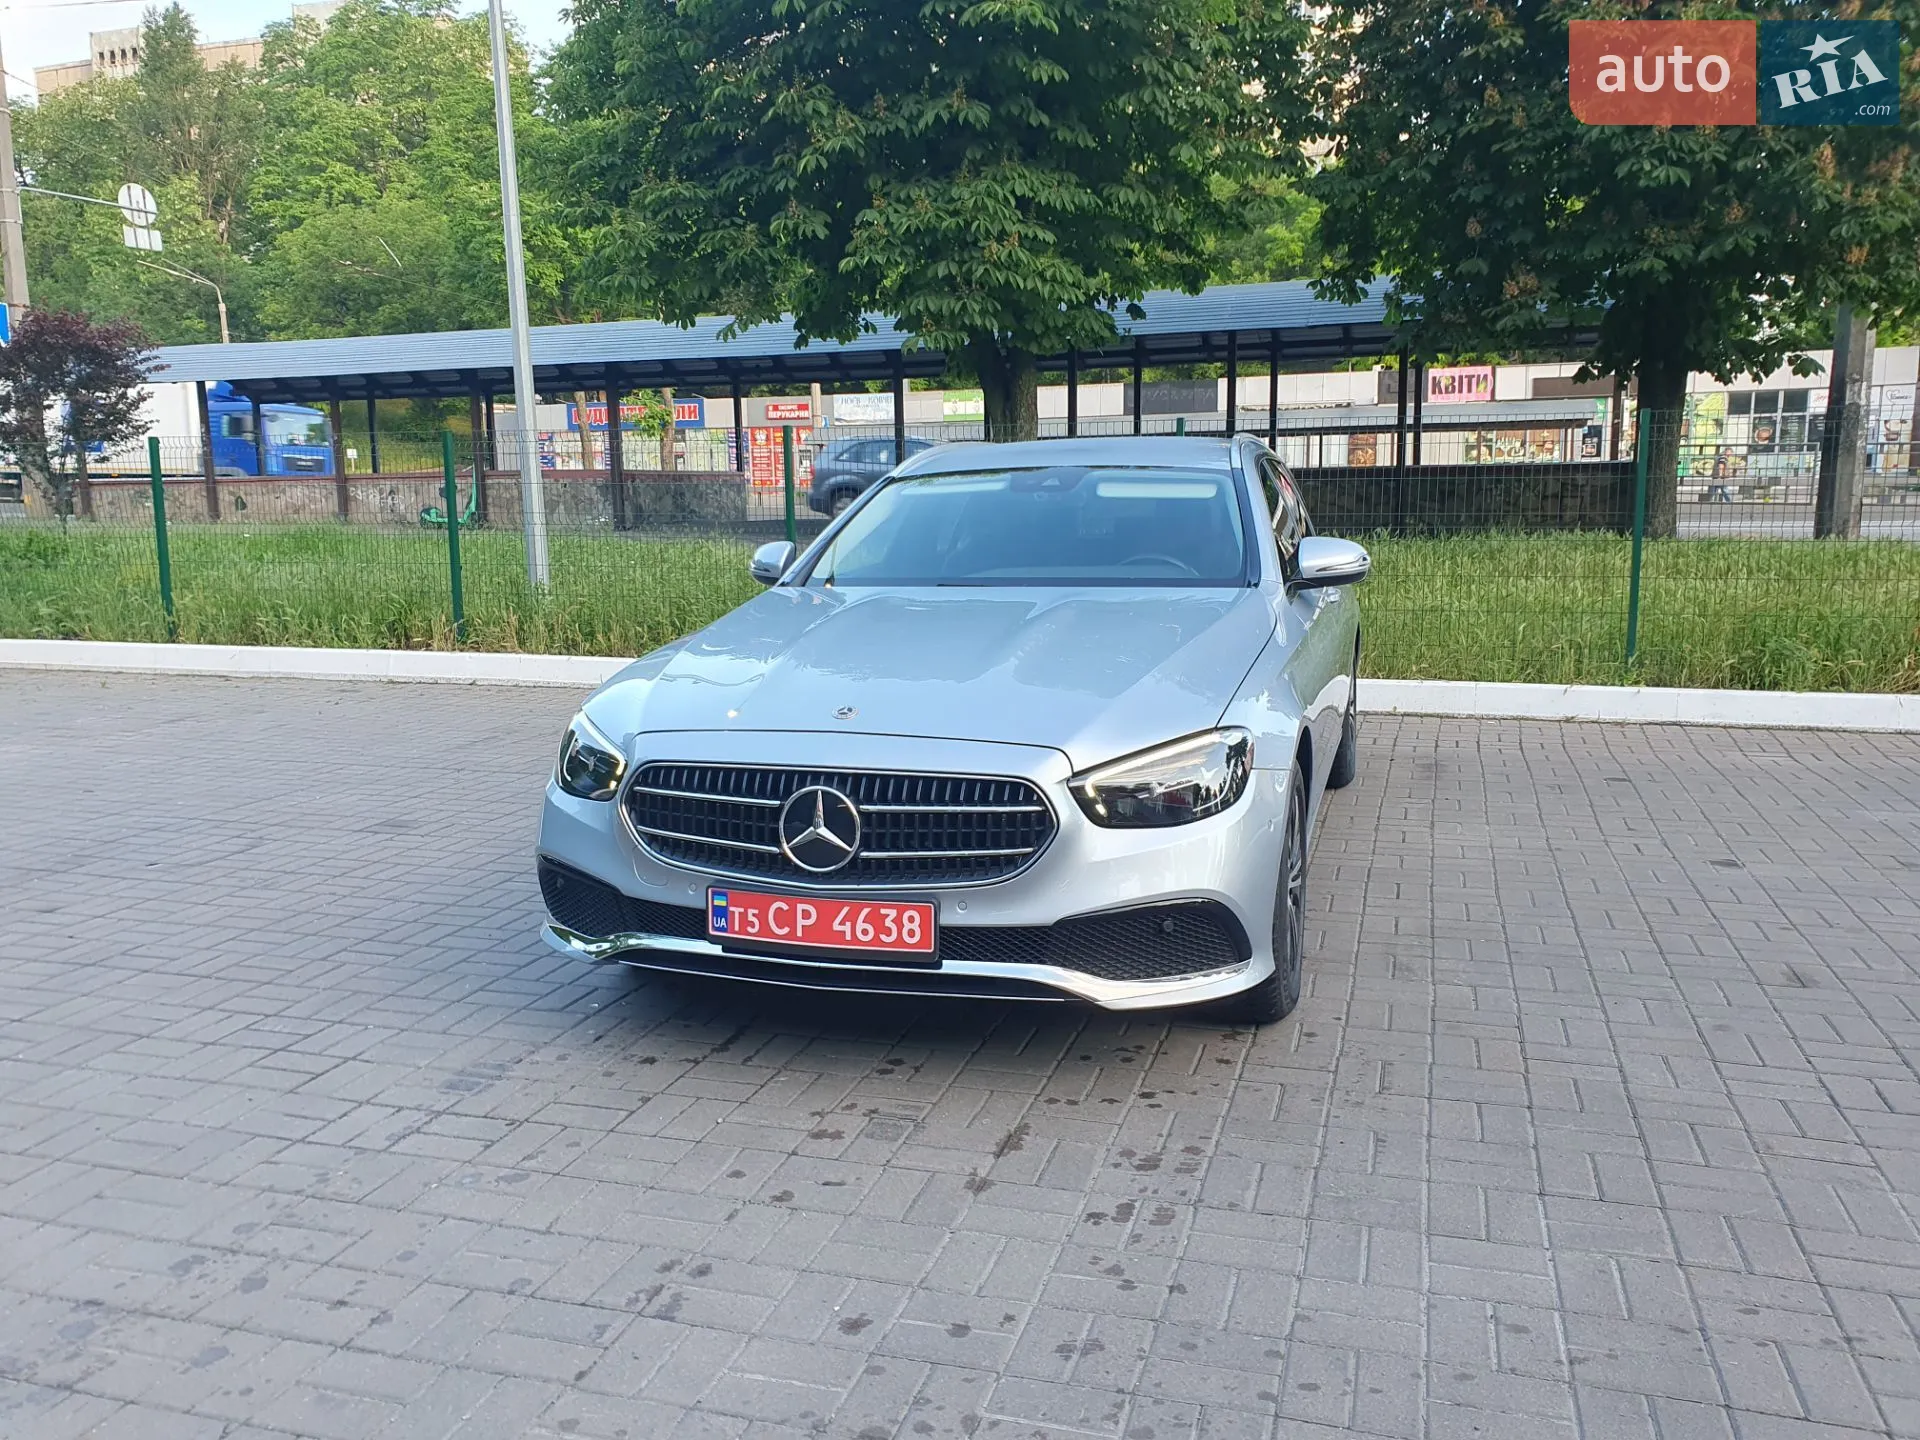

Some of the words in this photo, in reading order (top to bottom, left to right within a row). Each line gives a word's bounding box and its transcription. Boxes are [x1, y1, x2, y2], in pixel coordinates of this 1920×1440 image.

[1431, 374, 1488, 395] КВІТИ
[713, 916, 727, 928] UA
[832, 906, 921, 944] 4638
